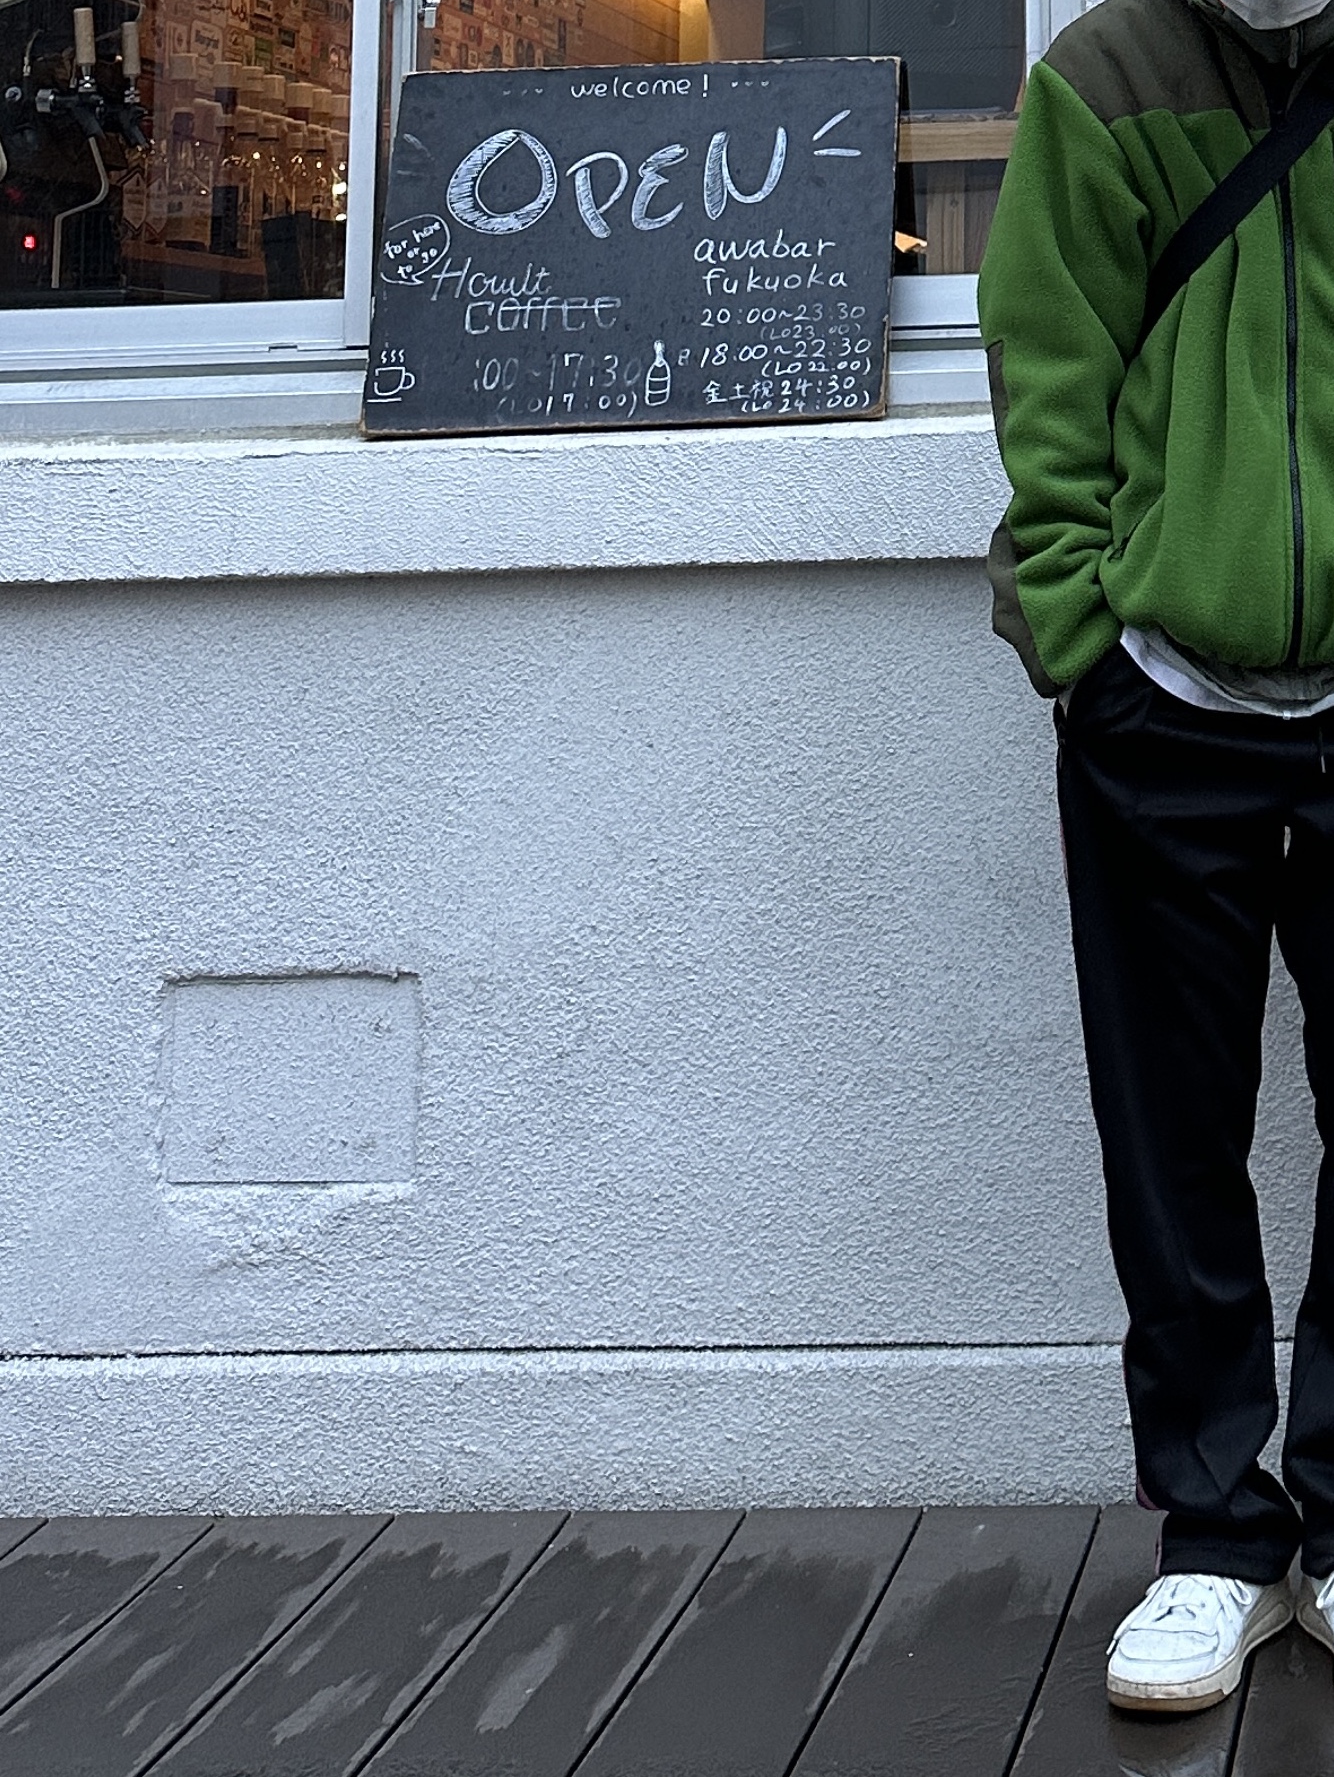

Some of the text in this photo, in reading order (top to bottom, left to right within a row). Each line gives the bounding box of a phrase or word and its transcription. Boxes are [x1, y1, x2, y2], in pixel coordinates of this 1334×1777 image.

[446, 127, 789, 239] OPEN
[421, 247, 439, 264] go
[693, 228, 836, 264] awabar
[702, 263, 849, 297] fukuoka
